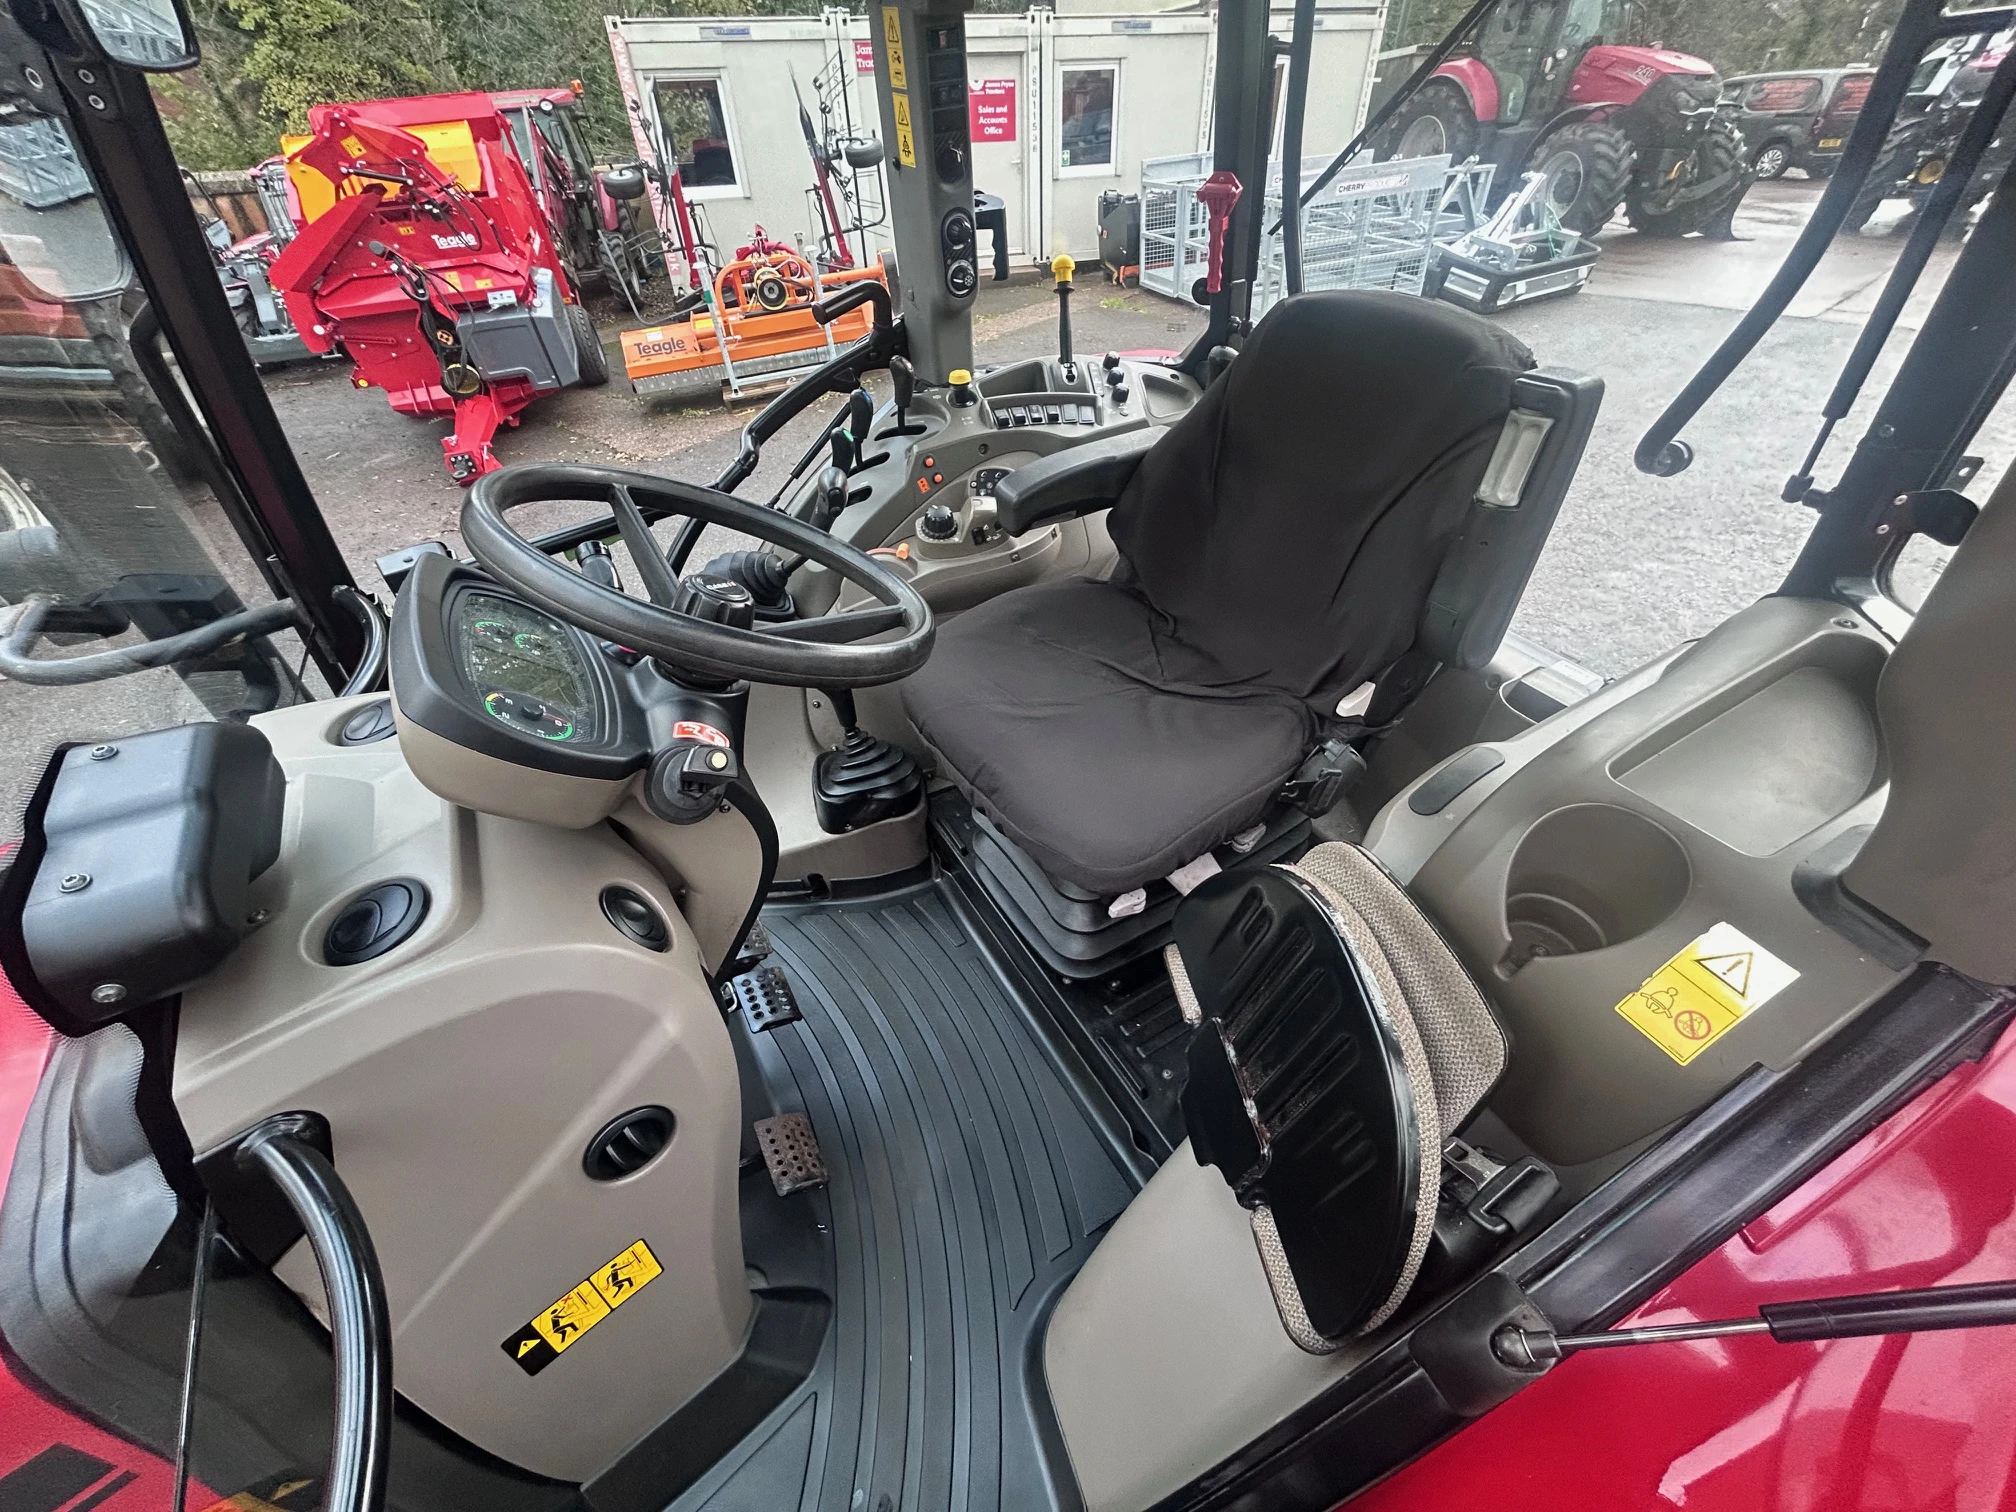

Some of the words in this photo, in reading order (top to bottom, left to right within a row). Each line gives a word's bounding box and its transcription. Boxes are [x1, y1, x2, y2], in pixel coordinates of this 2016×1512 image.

[978, 105, 994, 113] Sales
[978, 116, 1008, 124] Accounts
[984, 126, 1002, 134] Office
[1338, 182, 1366, 193] CHERRY
[430, 231, 478, 250] Teagle
[633, 337, 687, 358] Teagle
